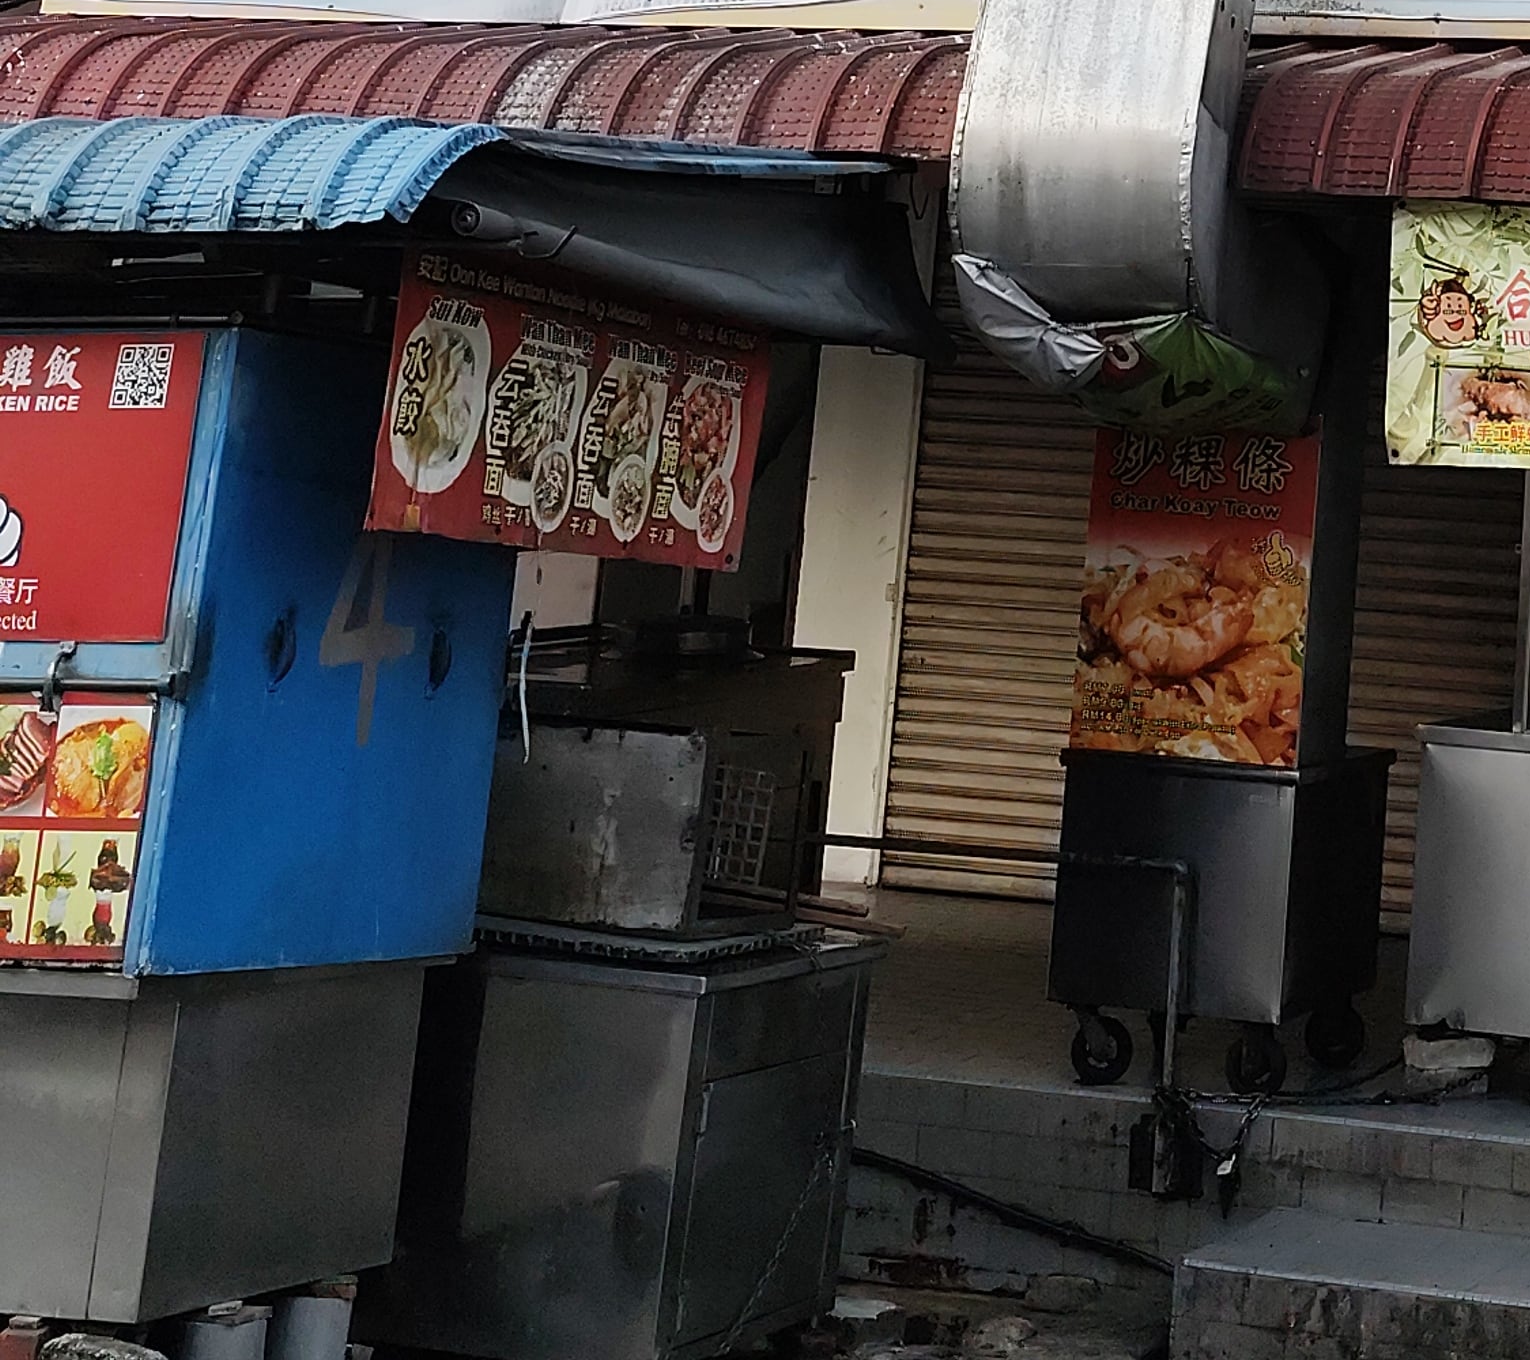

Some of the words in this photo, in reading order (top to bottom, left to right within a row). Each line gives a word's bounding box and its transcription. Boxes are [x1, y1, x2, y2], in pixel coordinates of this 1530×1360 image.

[430, 295, 452, 321] Sui
[452, 299, 485, 328] Kow
[34, 394, 81, 412] RICE
[483, 358, 530, 497] 云吞面
[573, 376, 619, 510] 云吞面
[1109, 489, 1160, 512] Char
[1162, 494, 1220, 519] Koay
[1222, 497, 1282, 521] Teow
